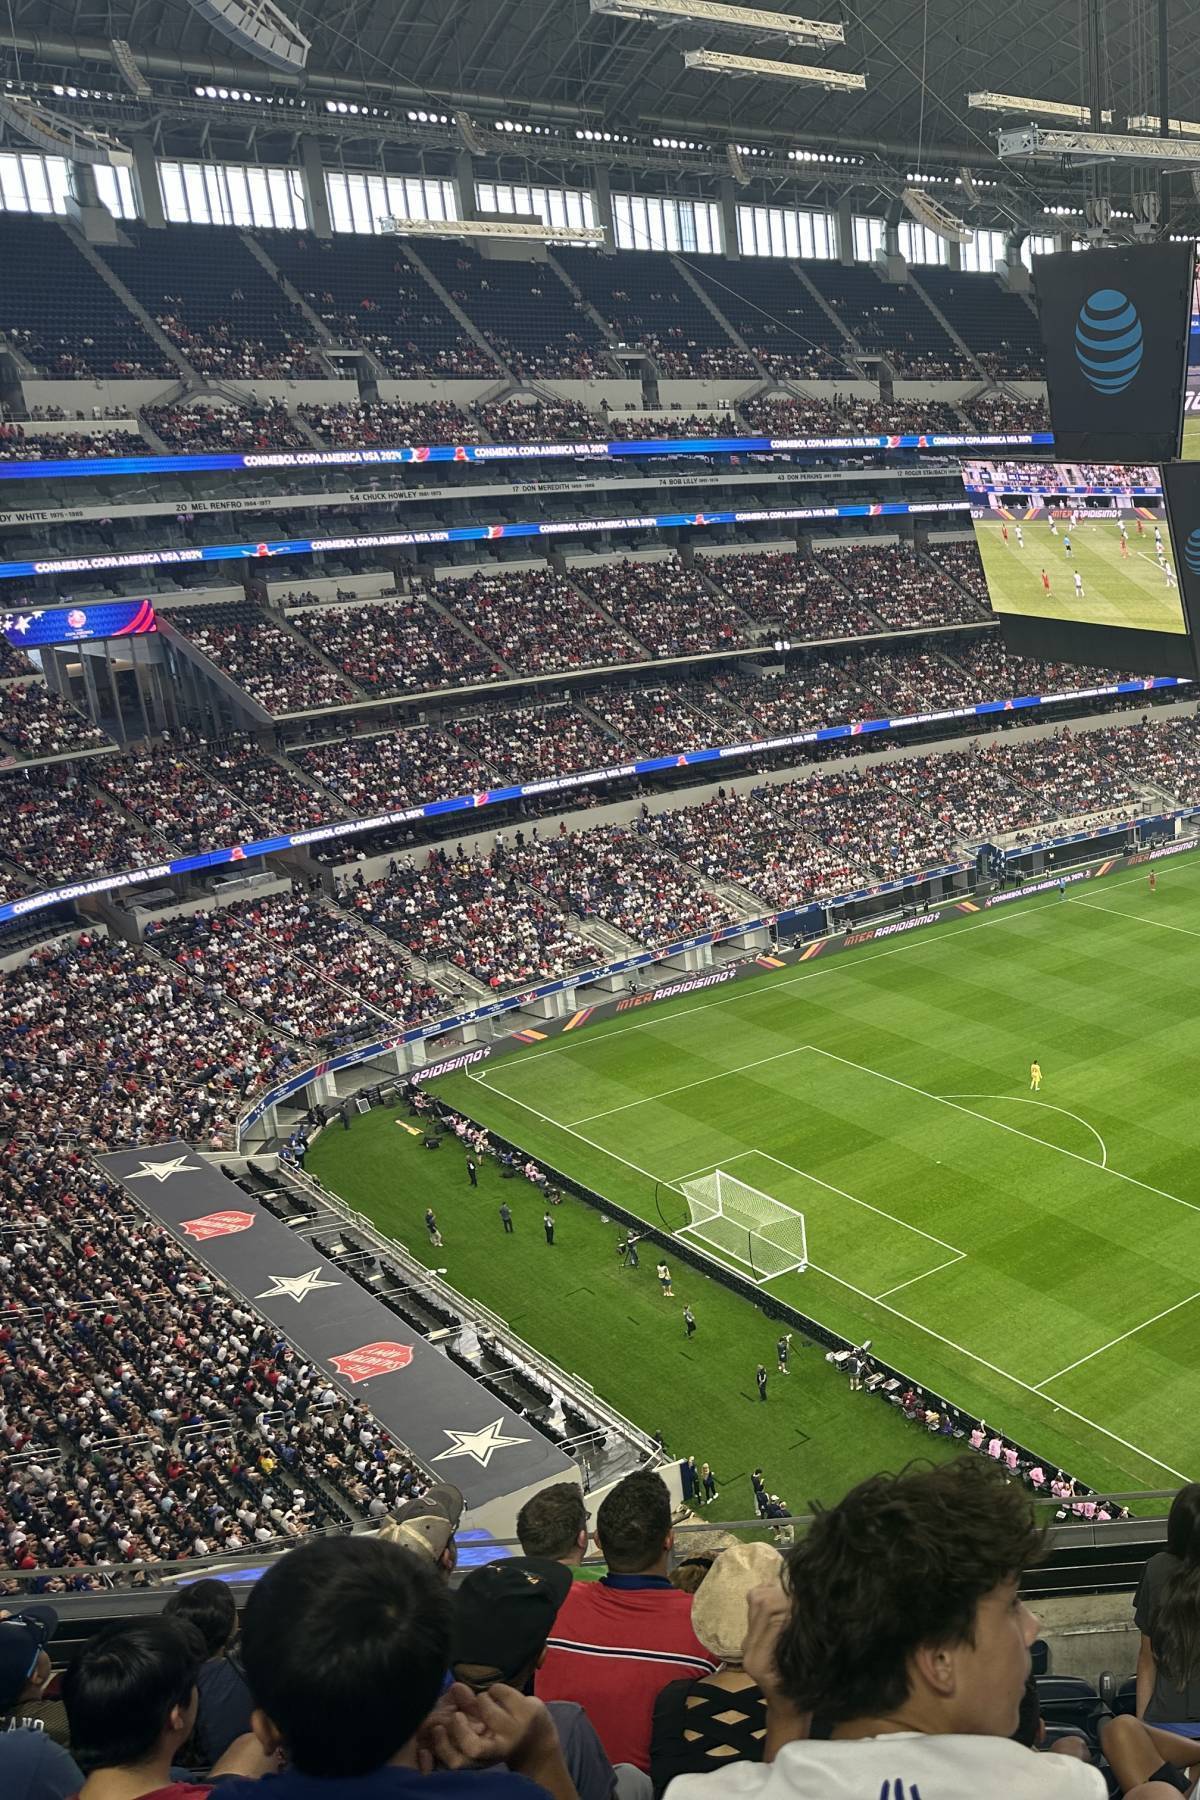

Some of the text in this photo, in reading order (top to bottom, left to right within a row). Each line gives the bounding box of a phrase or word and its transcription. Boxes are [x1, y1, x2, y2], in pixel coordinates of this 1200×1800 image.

[244, 450, 402, 466] CONMEBOL COPA AMERICA USA 2024
[474, 447, 520, 457] CONMEBOL
[520, 447, 541, 455] COPA
[541, 446, 574, 455] AMERICA
[16, 512, 48, 520] WHITE
[176, 504, 186, 512] 20
[210, 502, 241, 510] RENFRO
[540, 523, 578, 533] CONMEBOL
[578, 522, 598, 531] COPA
[597, 520, 626, 530] AMERICA
[312, 532, 448, 550] CONMEBOL COPA AMERICA USA 2024
[36, 551, 202, 572] CONMEBOL COPA AMERICA USA 2024
[290, 829, 335, 845] CONMEBOL
[335, 824, 356, 835] COPA
[356, 816, 390, 830] AMERICA
[1128, 841, 1194, 865] INTER RAPIDISIMO
[14, 865, 170, 913] CONMEBOL COPA AMERICA USA 2024
[1023, 886, 1037, 895] COPA
[844, 914, 935, 946] INTER RAPIDISIMO
[616, 972, 728, 1012] INTER RAPIDISIMO
